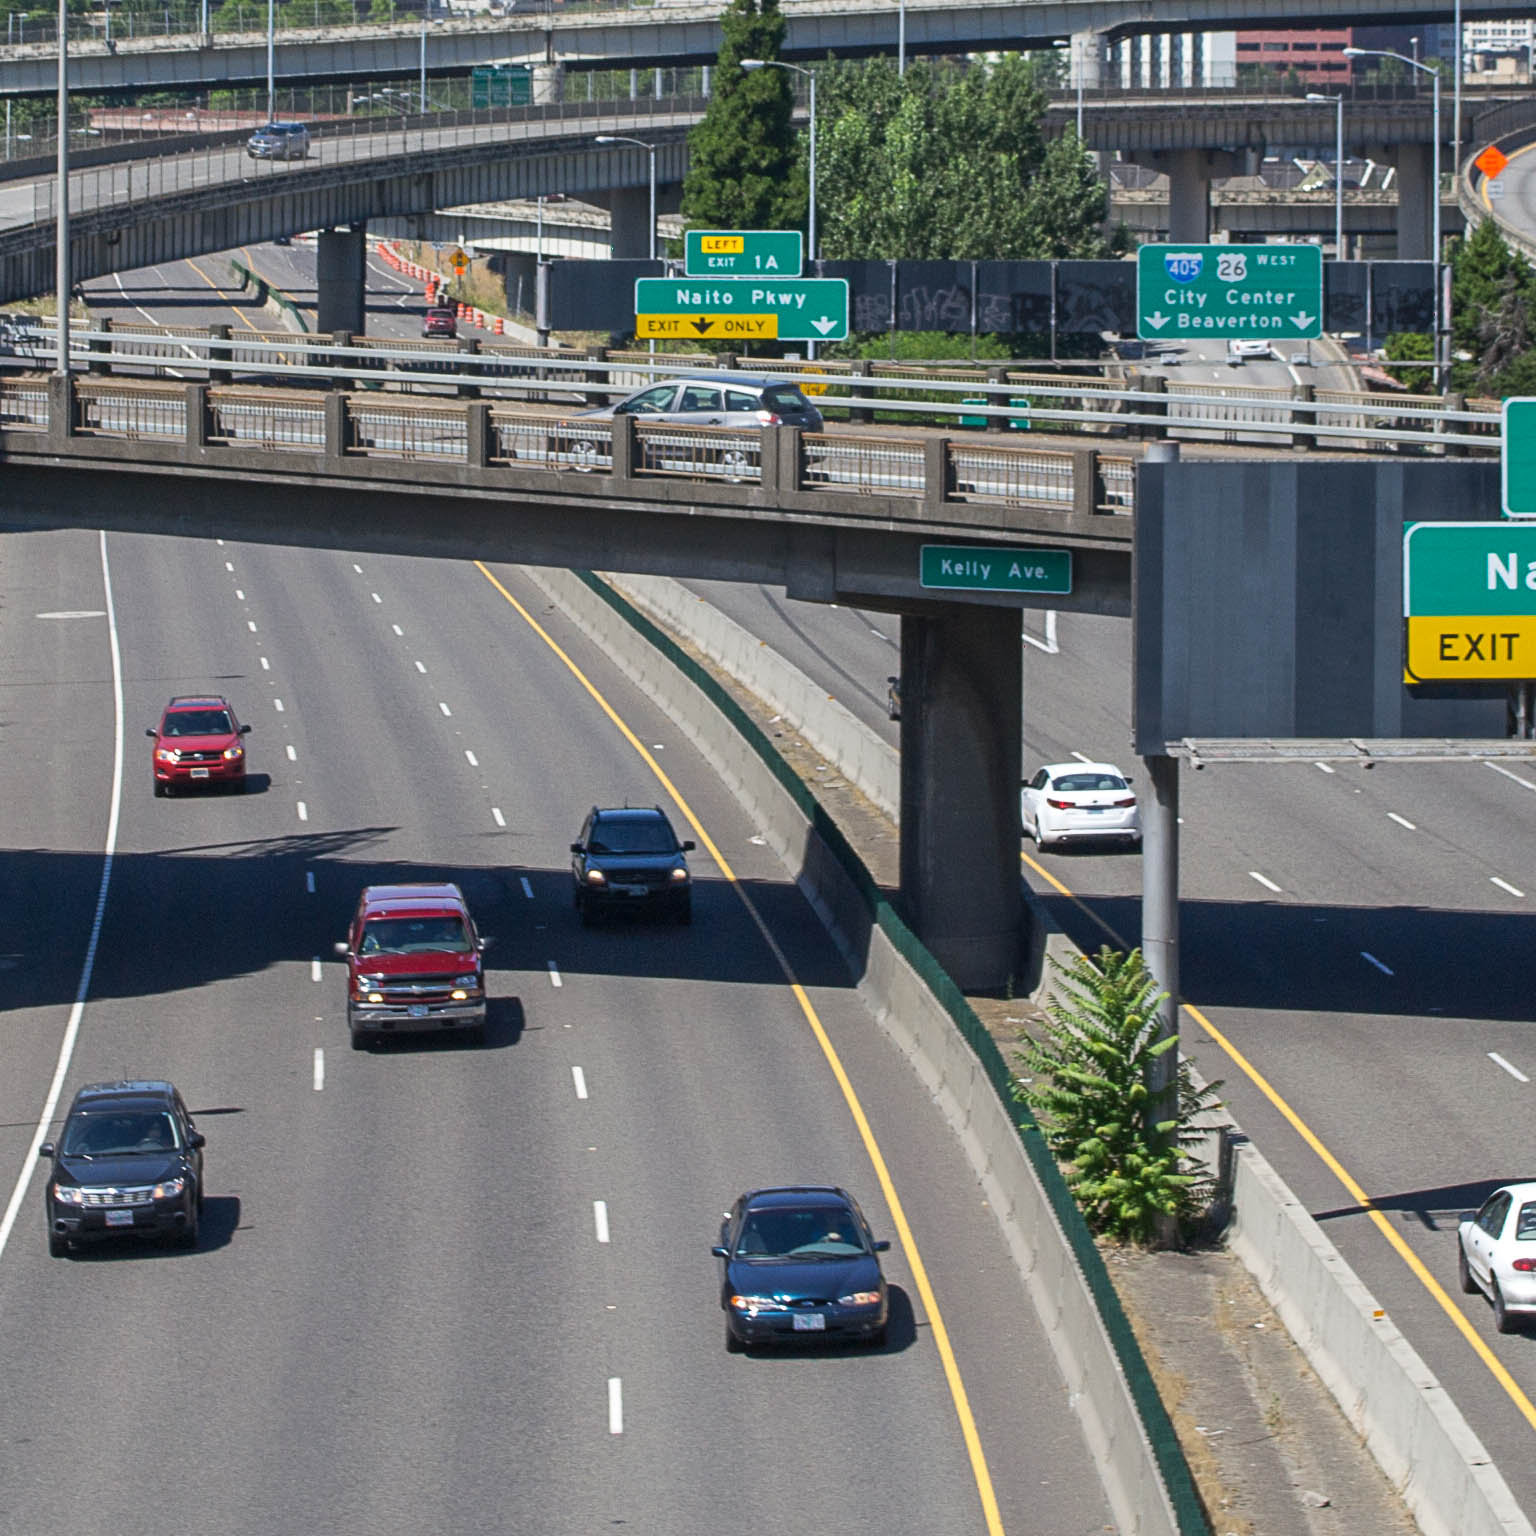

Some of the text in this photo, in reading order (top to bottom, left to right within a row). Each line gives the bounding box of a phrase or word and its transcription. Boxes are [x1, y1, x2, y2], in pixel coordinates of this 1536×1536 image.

[706, 239, 738, 250] LEFT
[707, 254, 779, 270] EXIT 1A
[1168, 253, 1297, 277] 405 26 WEST
[676, 288, 807, 309] Naito Pkwy
[1164, 288, 1296, 309] City Center
[647, 319, 766, 333] EXIT ONLY
[1177, 312, 1283, 329] Beaverton
[940, 559, 1049, 581] Kelly Ave.
[1438, 633, 1521, 661] EXIT
